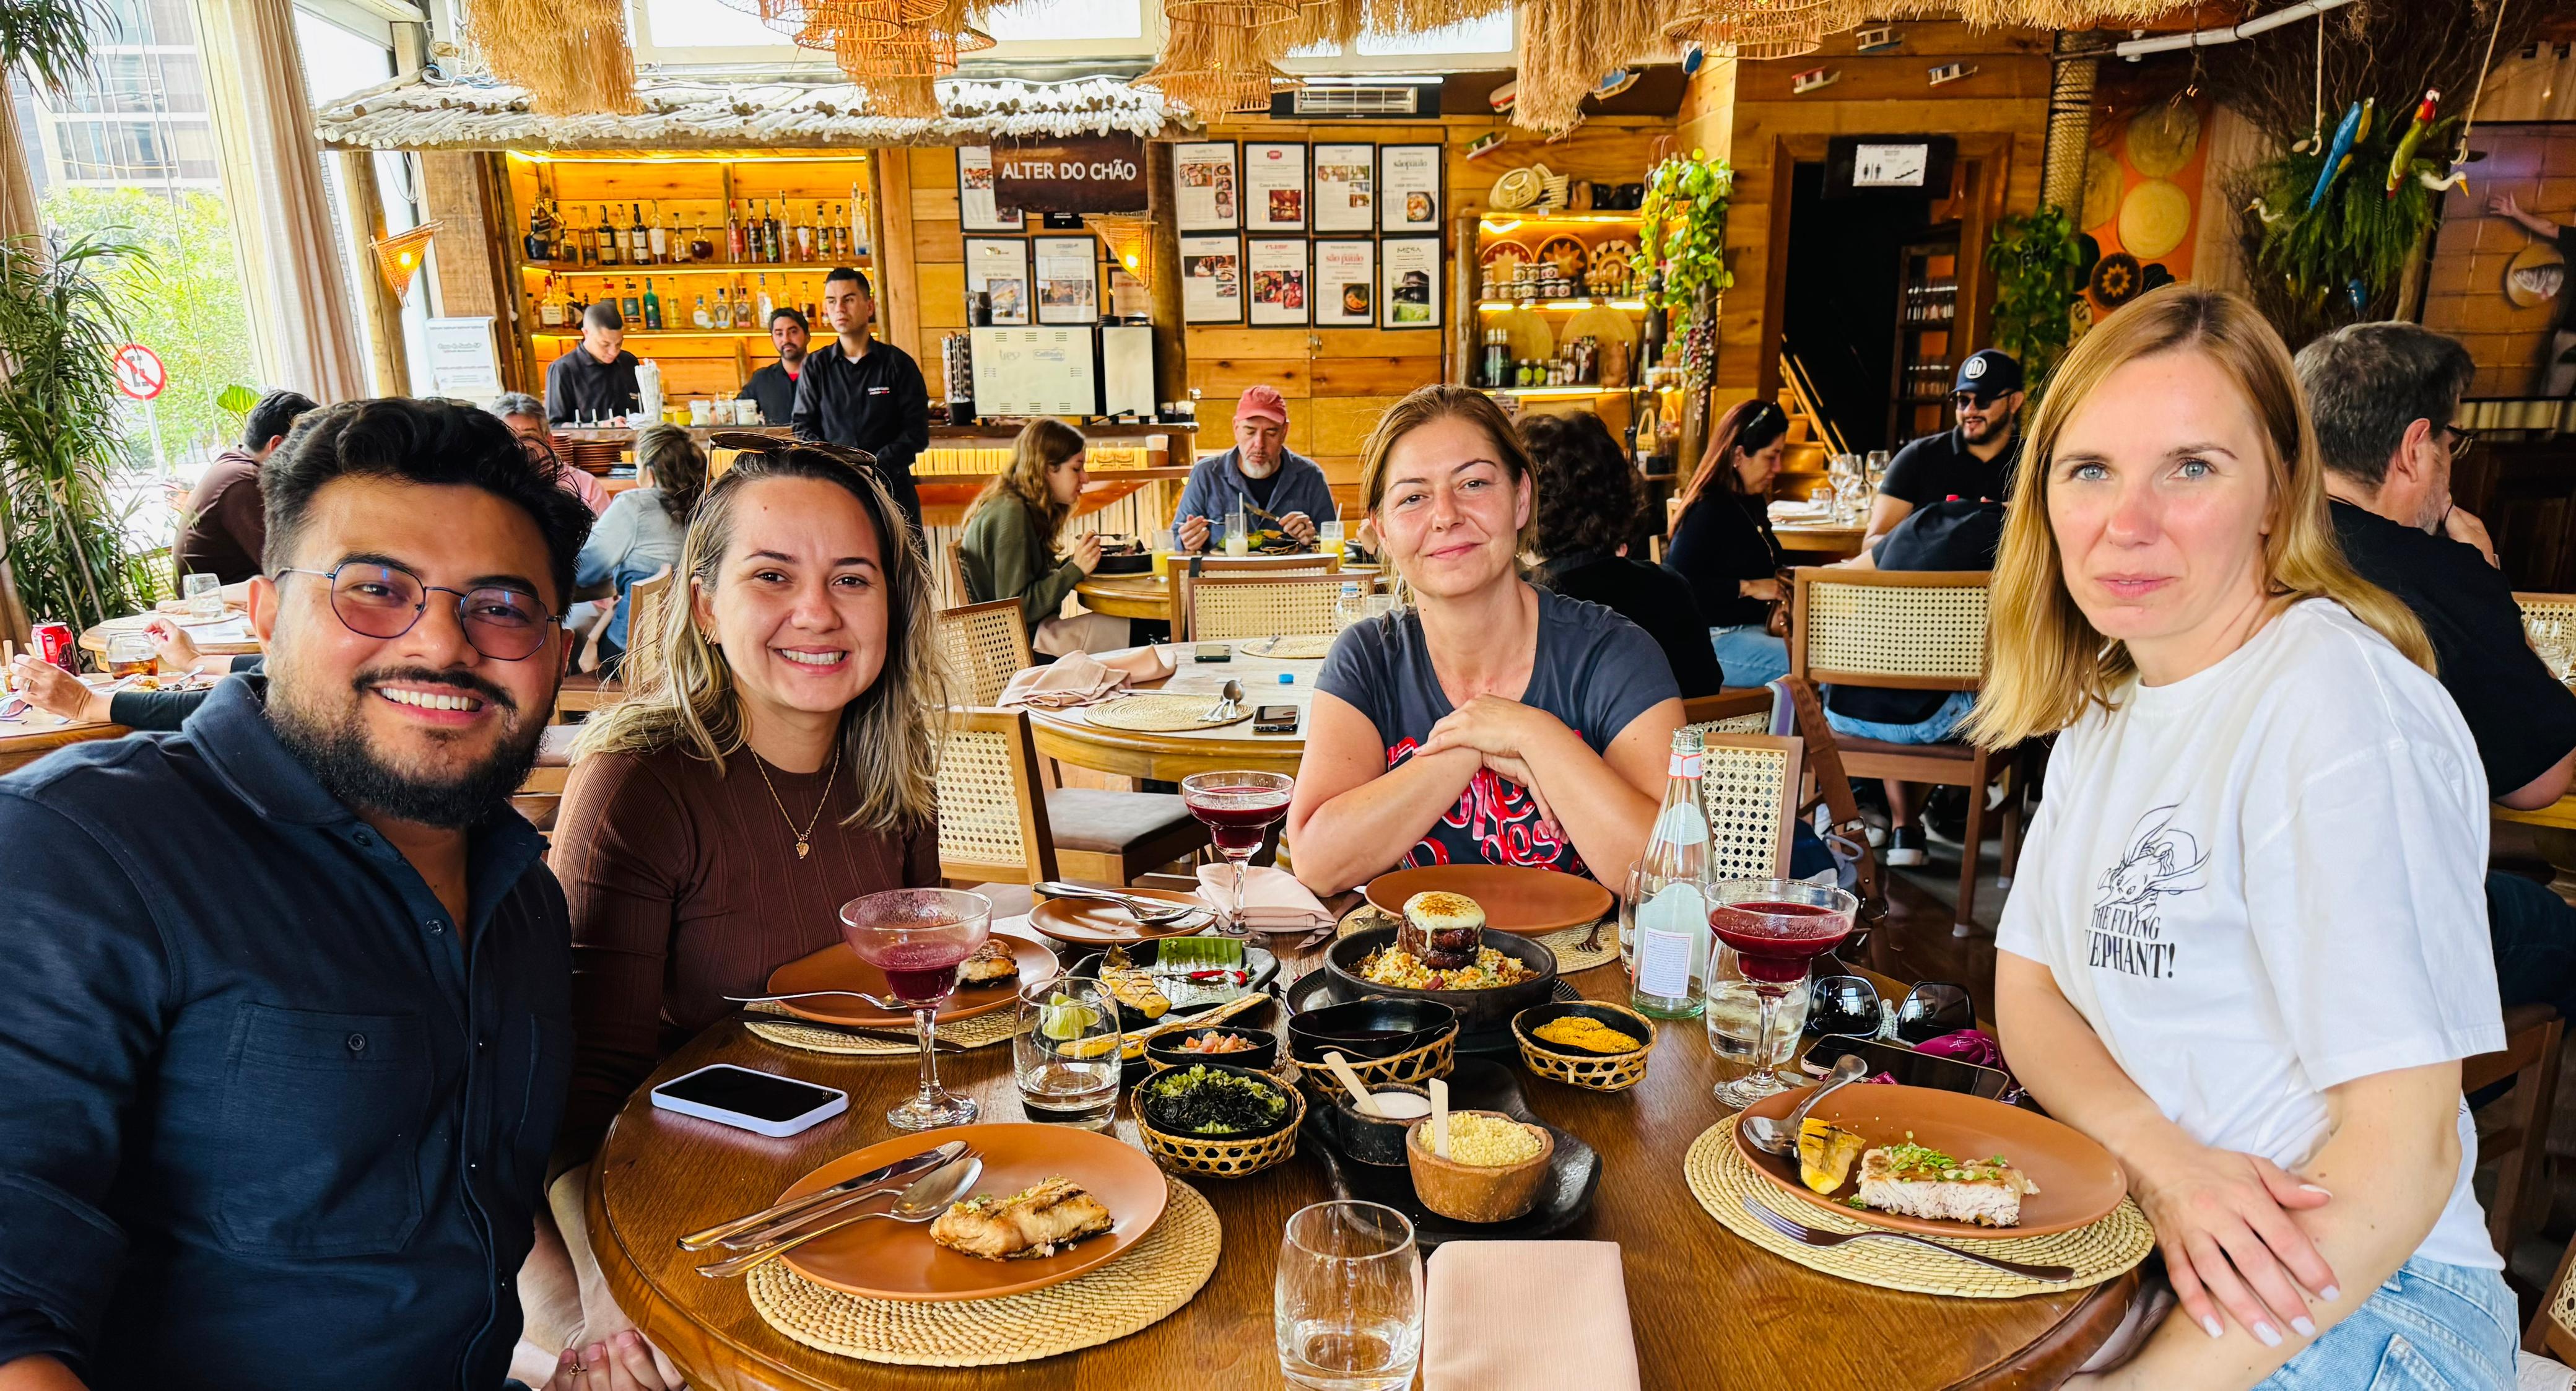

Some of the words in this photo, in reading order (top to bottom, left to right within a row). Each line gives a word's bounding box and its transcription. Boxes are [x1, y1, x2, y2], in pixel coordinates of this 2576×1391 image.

[1001, 162, 1056, 180] ALTER
[1060, 162, 1086, 180] DO
[1090, 159, 1137, 181] CHÃO
[2091, 904, 2112, 930] THE
[2111, 908, 2160, 940] FLYING
